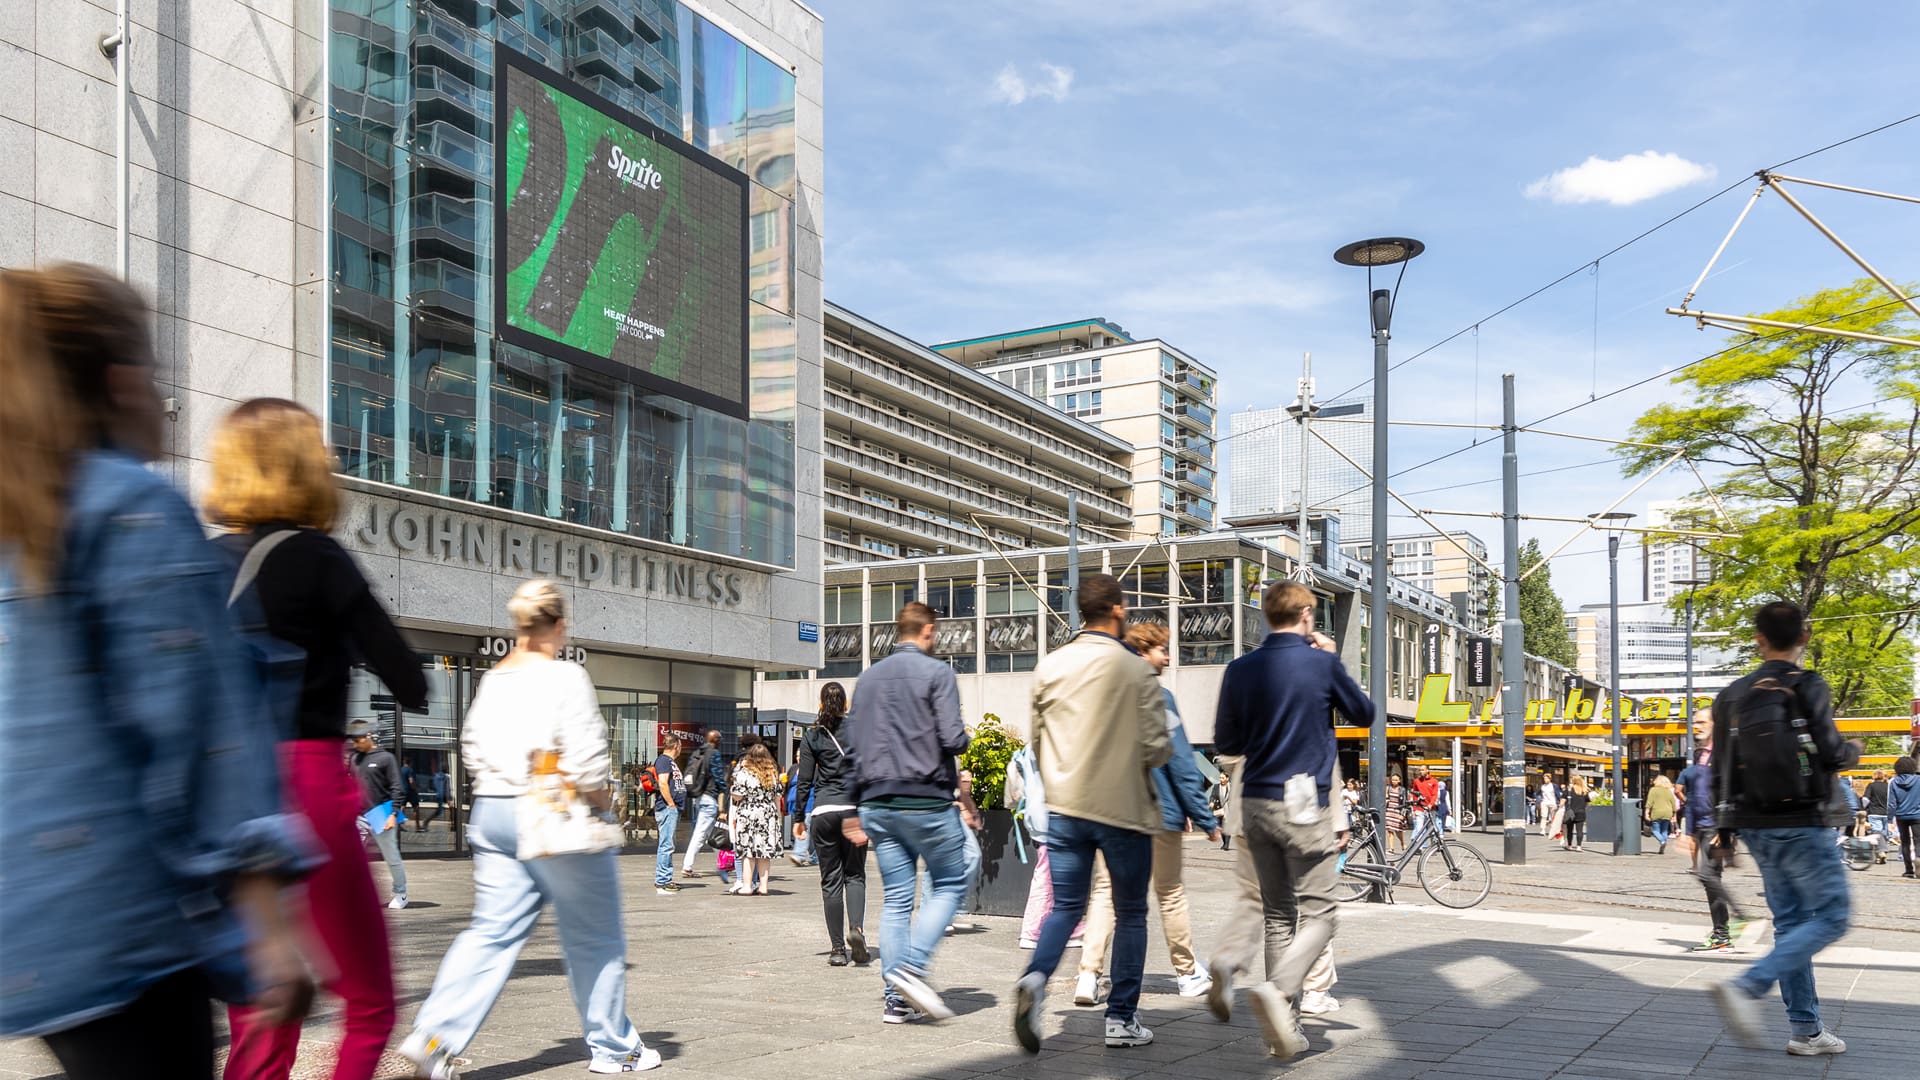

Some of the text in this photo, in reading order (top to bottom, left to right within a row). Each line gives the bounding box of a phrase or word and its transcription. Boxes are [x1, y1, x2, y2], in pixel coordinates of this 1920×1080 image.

[608, 145, 662, 190] Sprite
[604, 307, 665, 337] HEAT HAPPENS
[616, 321, 645, 340] STAY COOL
[360, 504, 742, 605] JOHN REED FITNESS
[1426, 624, 1440, 634] JD
[1415, 673, 1712, 734] Linbaan
